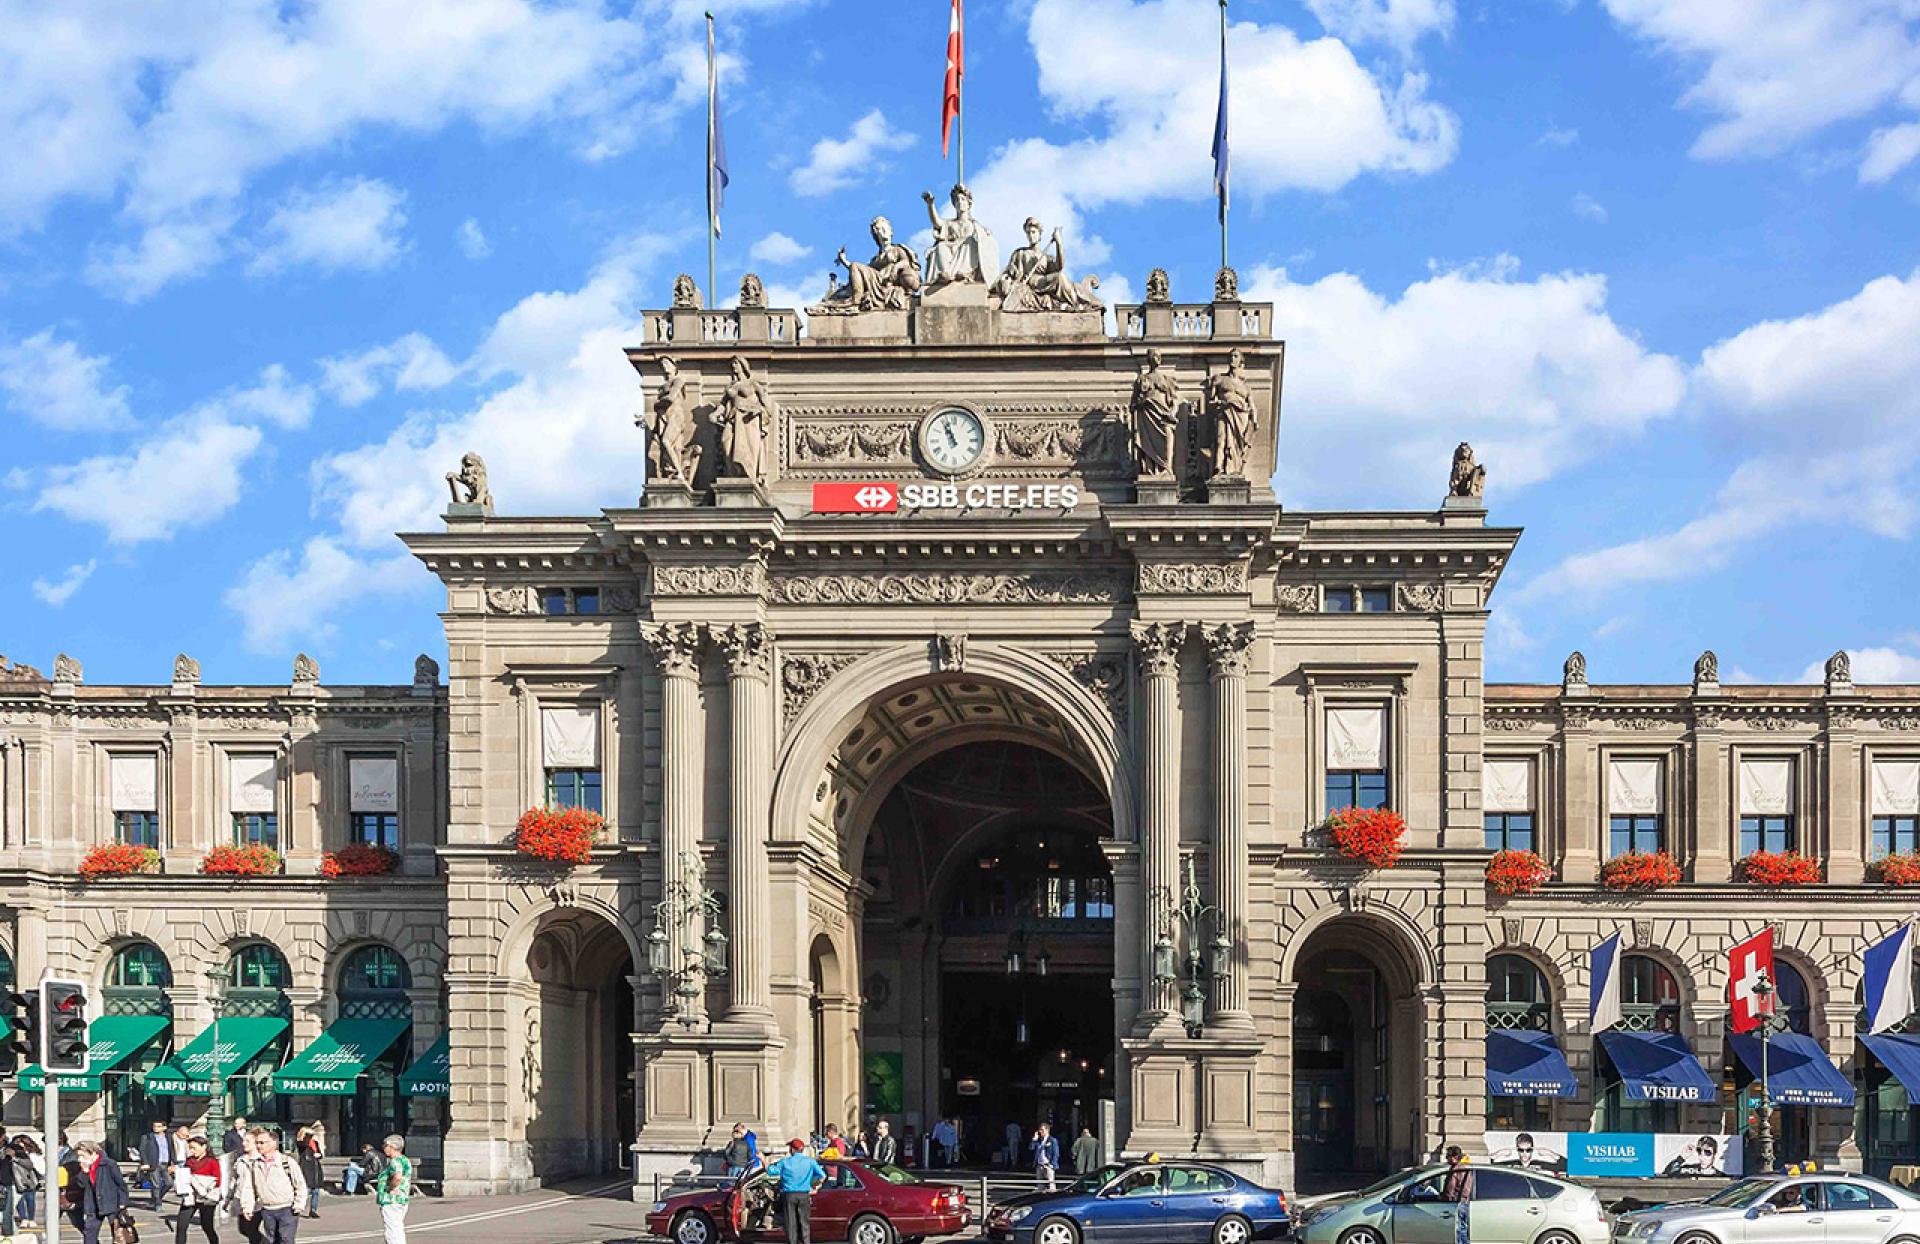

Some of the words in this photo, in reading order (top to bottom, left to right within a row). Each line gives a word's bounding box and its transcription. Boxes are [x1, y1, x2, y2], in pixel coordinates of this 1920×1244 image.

[903, 484, 958, 508] SBB
[283, 1080, 347, 1091] PHARMACY
[410, 1083, 450, 1093] APOTH
[1641, 1085, 1699, 1100] VISILAB
[1585, 1144, 1637, 1157] VISILAB
